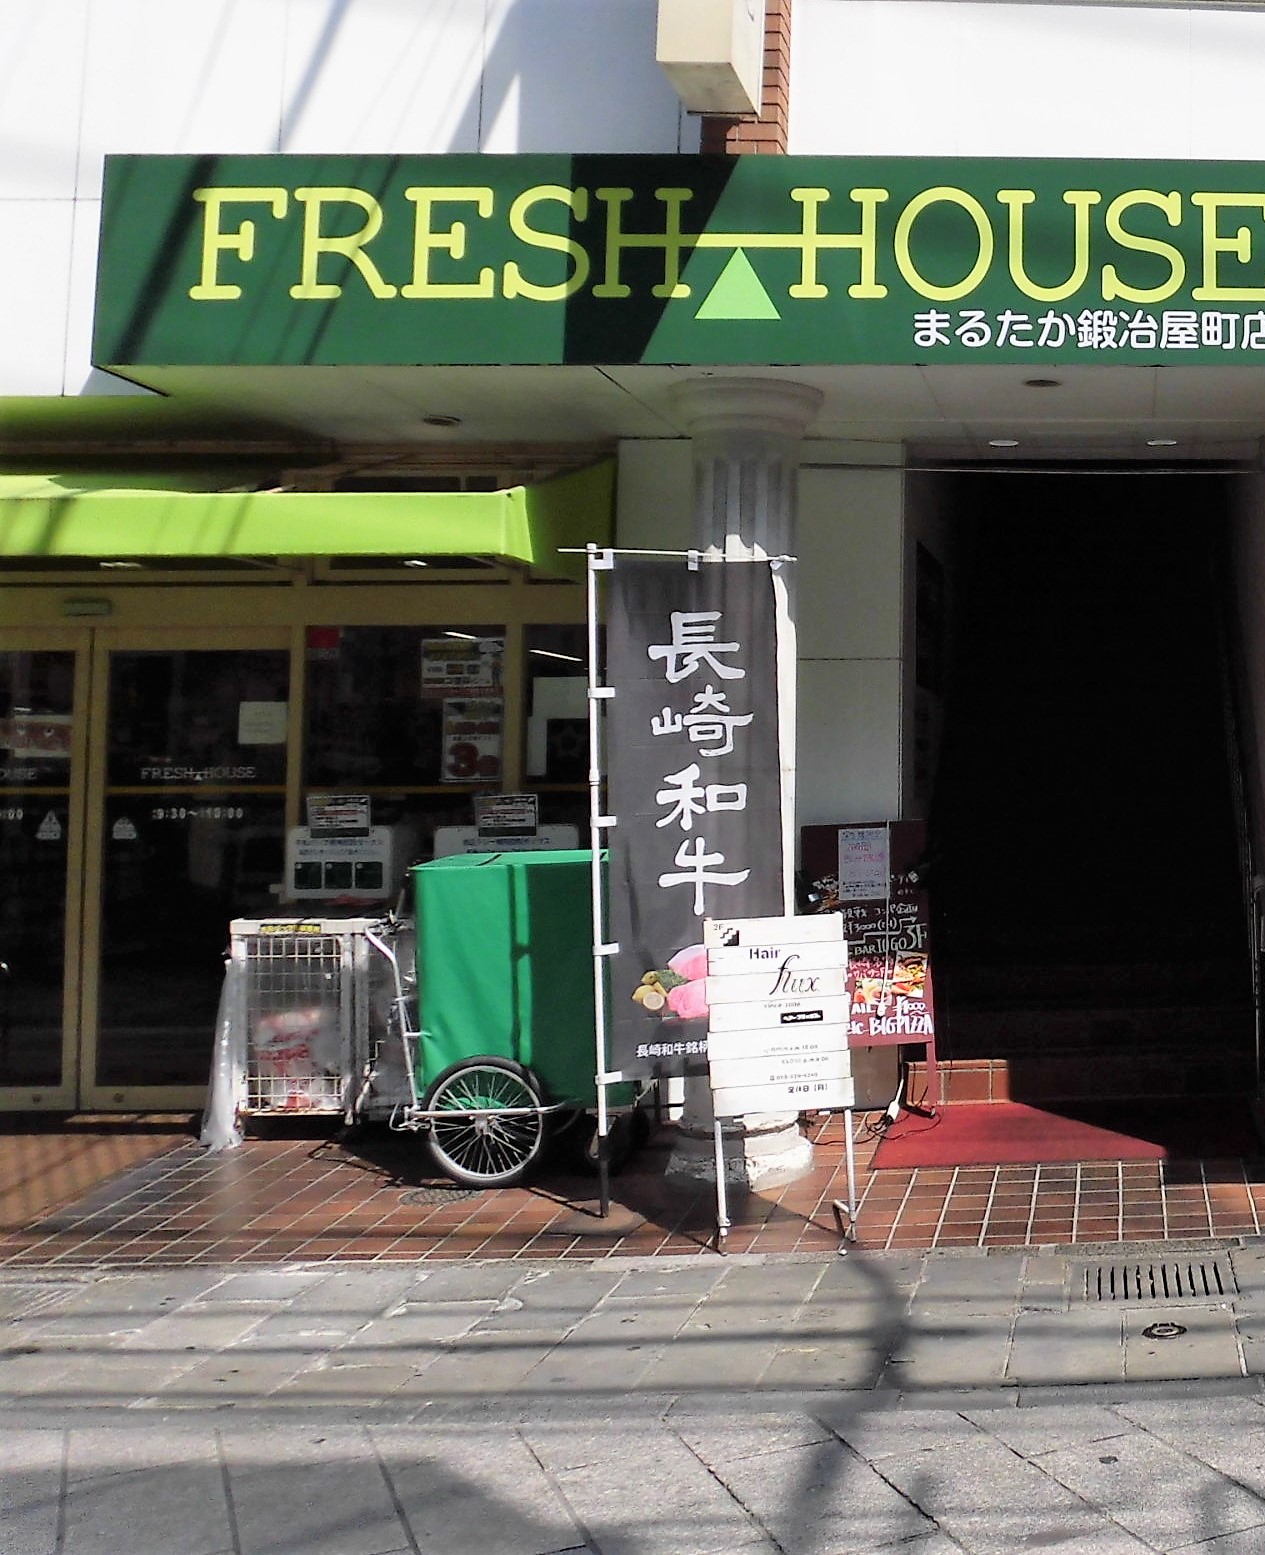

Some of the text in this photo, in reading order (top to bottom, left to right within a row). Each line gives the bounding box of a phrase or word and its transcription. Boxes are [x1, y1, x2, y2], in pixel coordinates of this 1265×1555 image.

[189, 184, 693, 301] FRESH
[140, 766, 256, 780] FRESH HOUSE
[647, 610, 755, 916] 長崎和牛
[749, 947, 781, 960] Hair
[769, 954, 820, 996] flux
